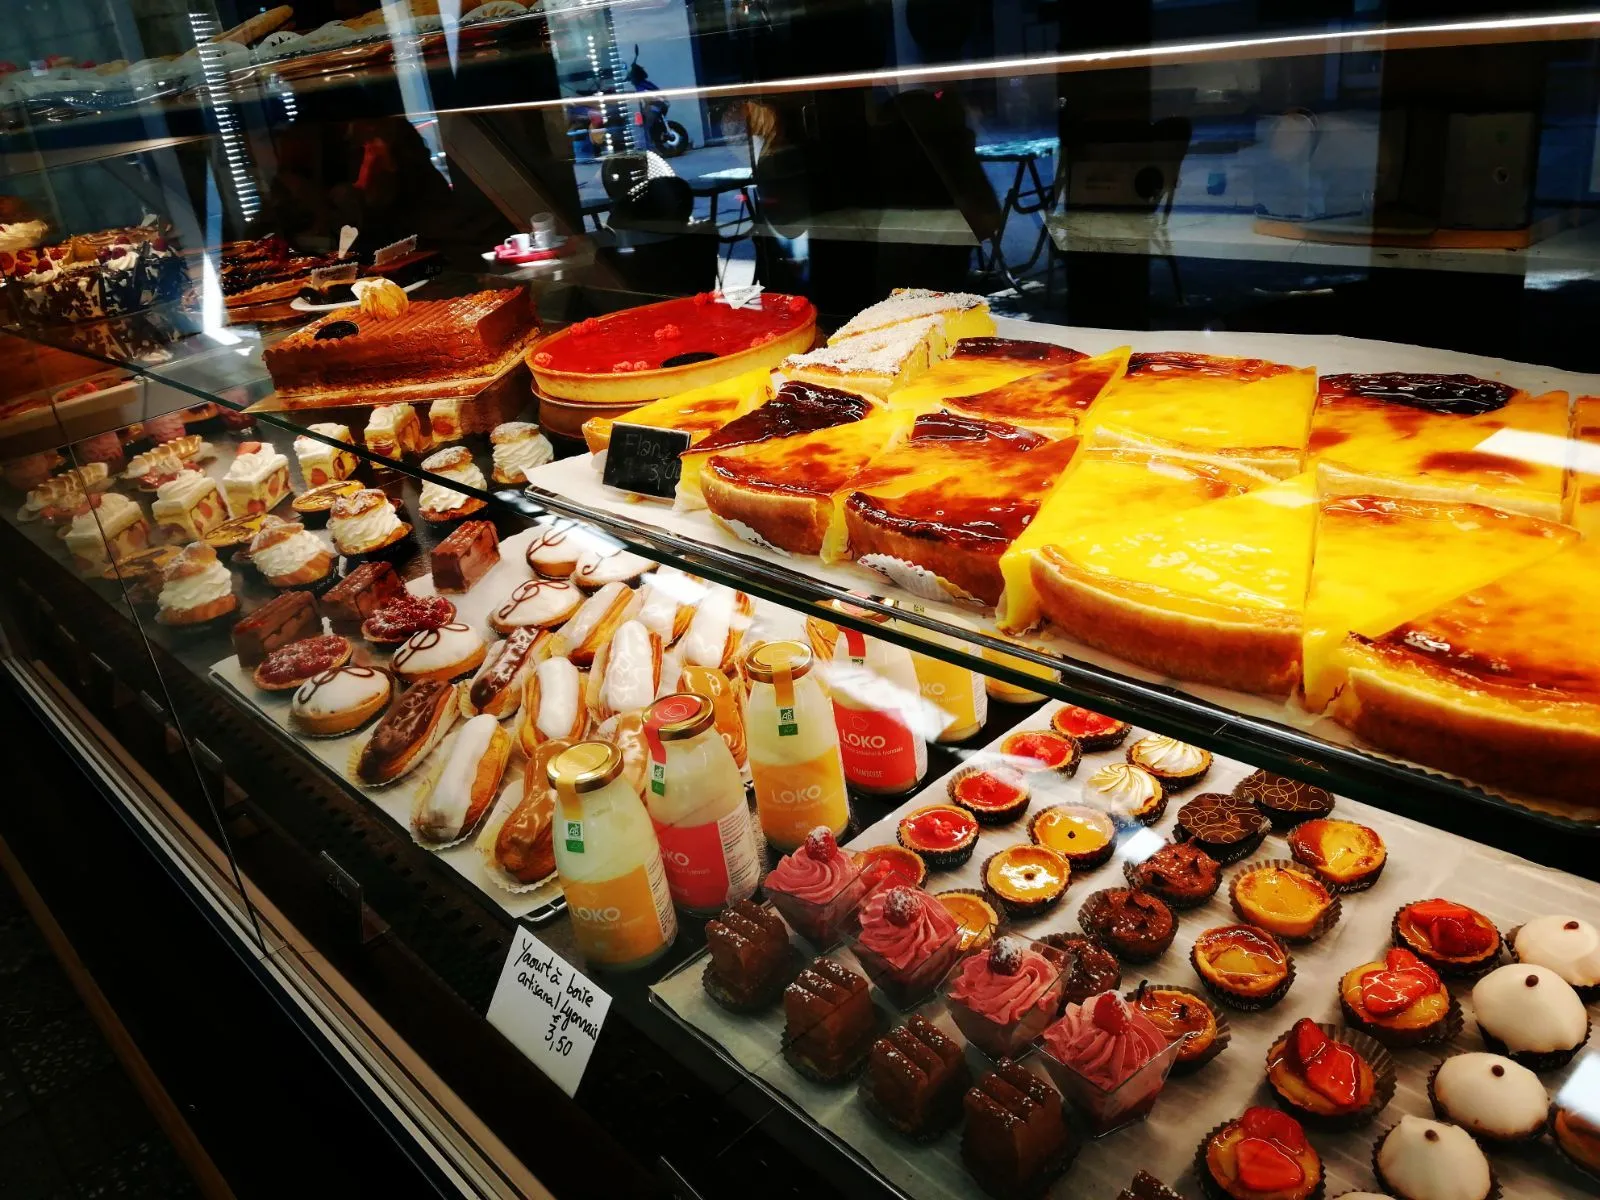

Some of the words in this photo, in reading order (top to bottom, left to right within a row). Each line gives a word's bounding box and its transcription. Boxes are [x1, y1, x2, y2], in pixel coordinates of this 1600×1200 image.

[625, 433, 661, 457] Flan
[921, 682, 946, 696] KO
[842, 728, 887, 749] LOKO
[771, 784, 822, 804] LOKO
[568, 902, 621, 923] LOKO
[514, 938, 554, 978] Yaourt
[550, 966, 563, 986] à
[517, 972, 562, 1010] artisanal
[560, 999, 599, 1041] Lyonnais
[544, 1023, 574, 1057] 3,50
